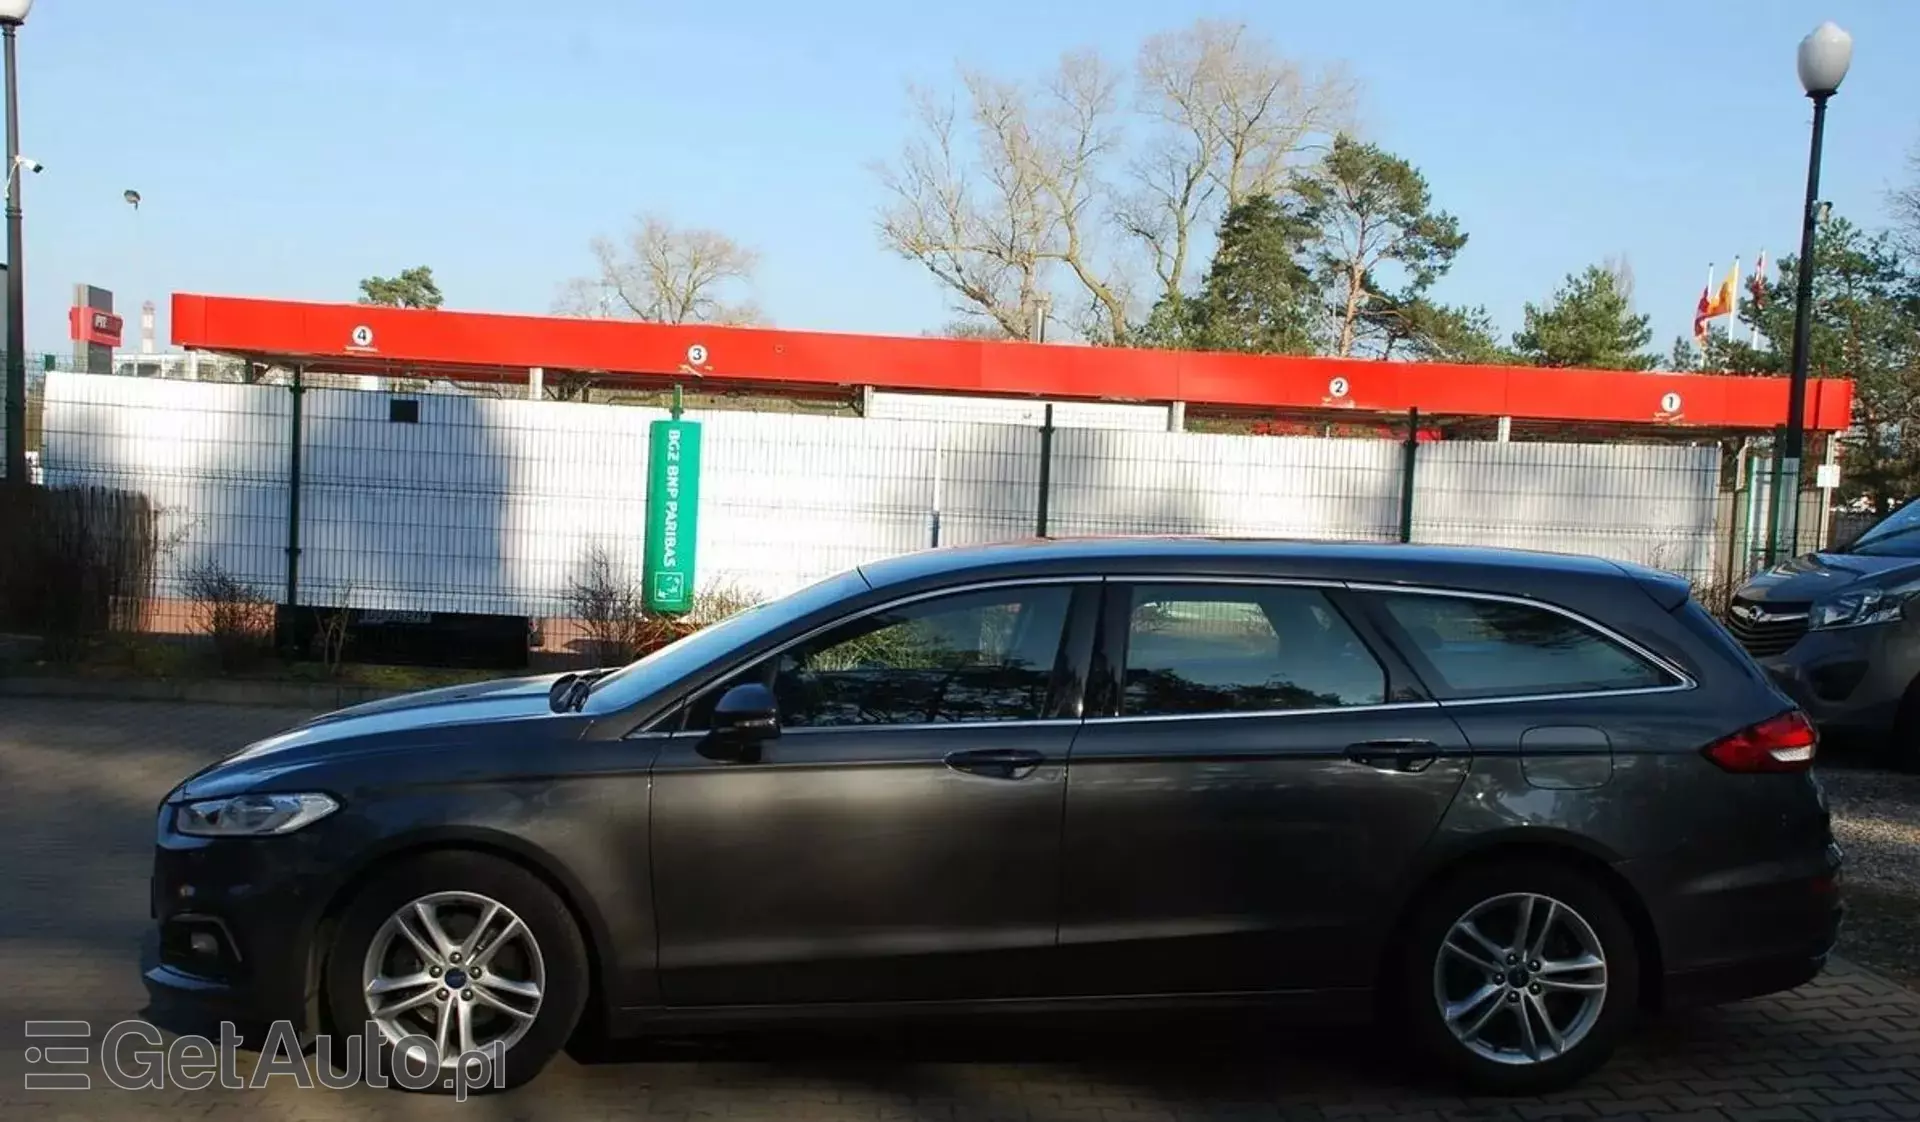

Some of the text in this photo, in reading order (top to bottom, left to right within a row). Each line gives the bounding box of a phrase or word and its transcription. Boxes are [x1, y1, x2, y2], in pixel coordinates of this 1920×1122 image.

[357, 328, 367, 341] 4
[693, 347, 702, 361] 3
[1334, 380, 1344, 393] 2
[666, 465, 680, 498] BNP
[663, 501, 678, 568] PARIBAS
